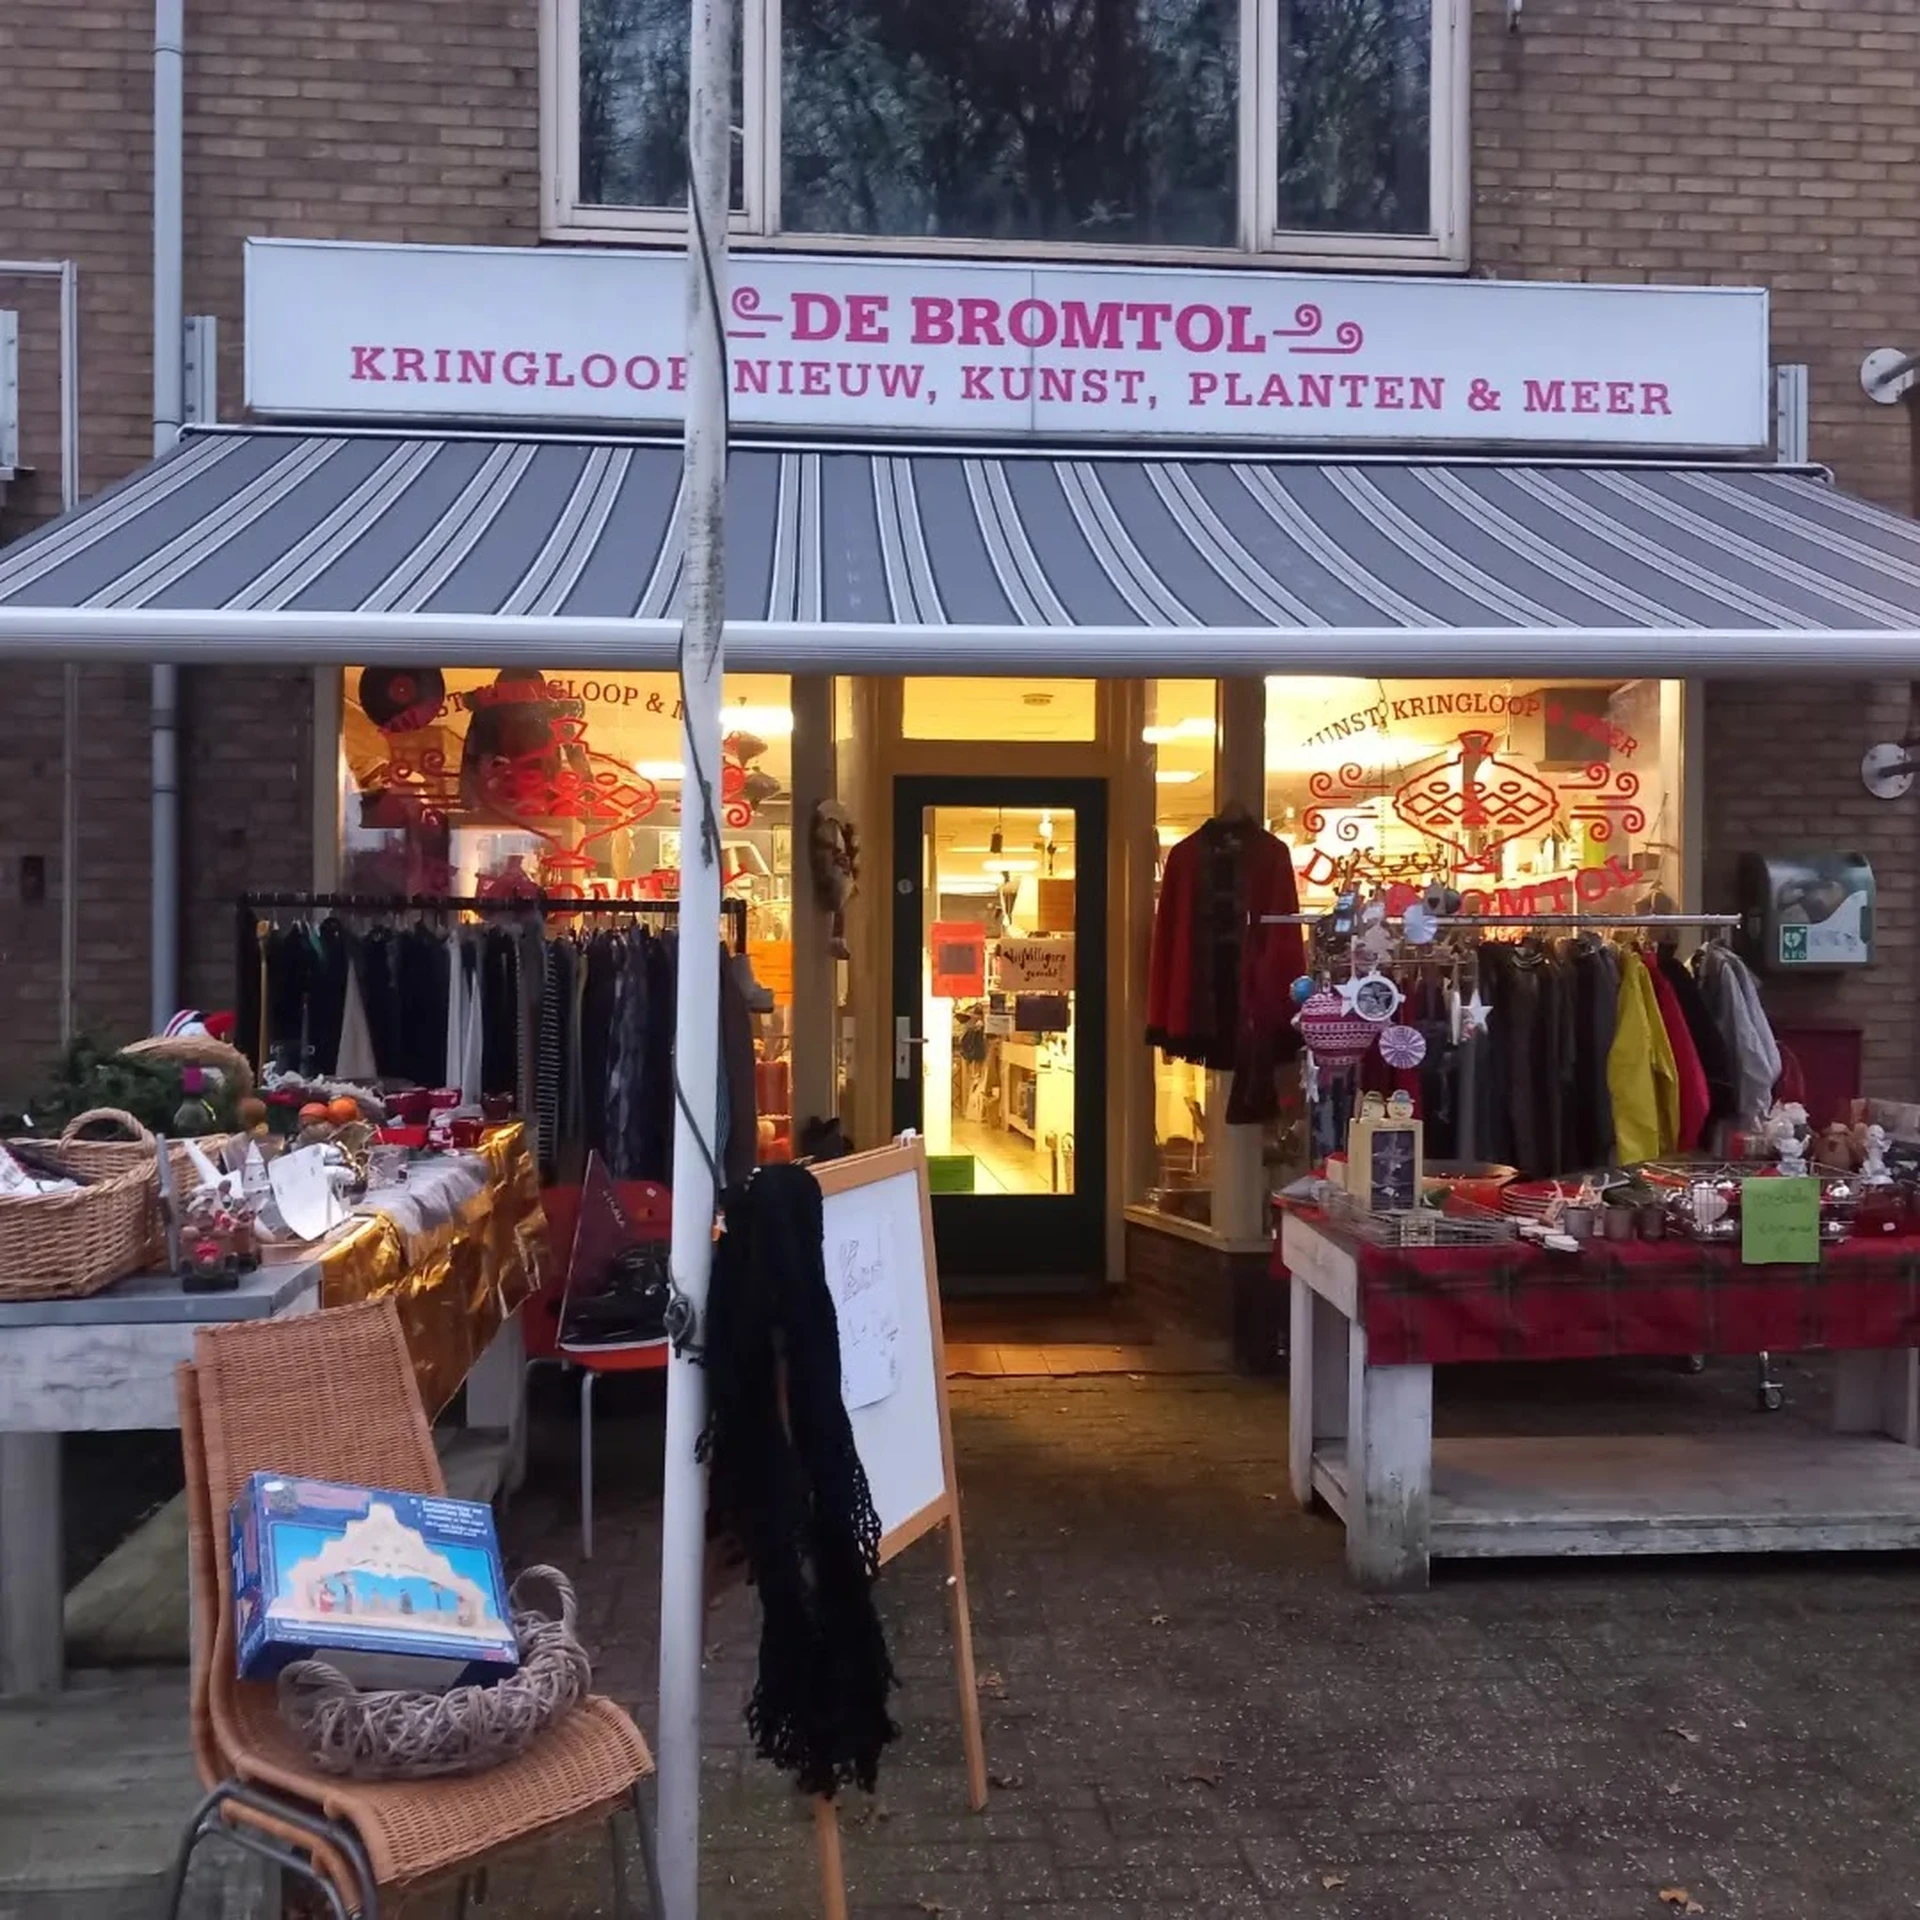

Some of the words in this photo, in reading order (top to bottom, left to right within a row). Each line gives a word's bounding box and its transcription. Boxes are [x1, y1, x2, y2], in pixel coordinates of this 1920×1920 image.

[790, 292, 890, 344] DE
[912, 295, 1266, 355] BROMTOL
[734, 359, 937, 405] NIEUW,
[961, 365, 1157, 409] KUNST,
[1189, 372, 1444, 410] PLANTEN
[1467, 377, 1501, 412] &
[1524, 379, 1672, 416] MEER
[645, 692, 665, 714] &
[1391, 692, 1540, 720] KRINGLOOP
